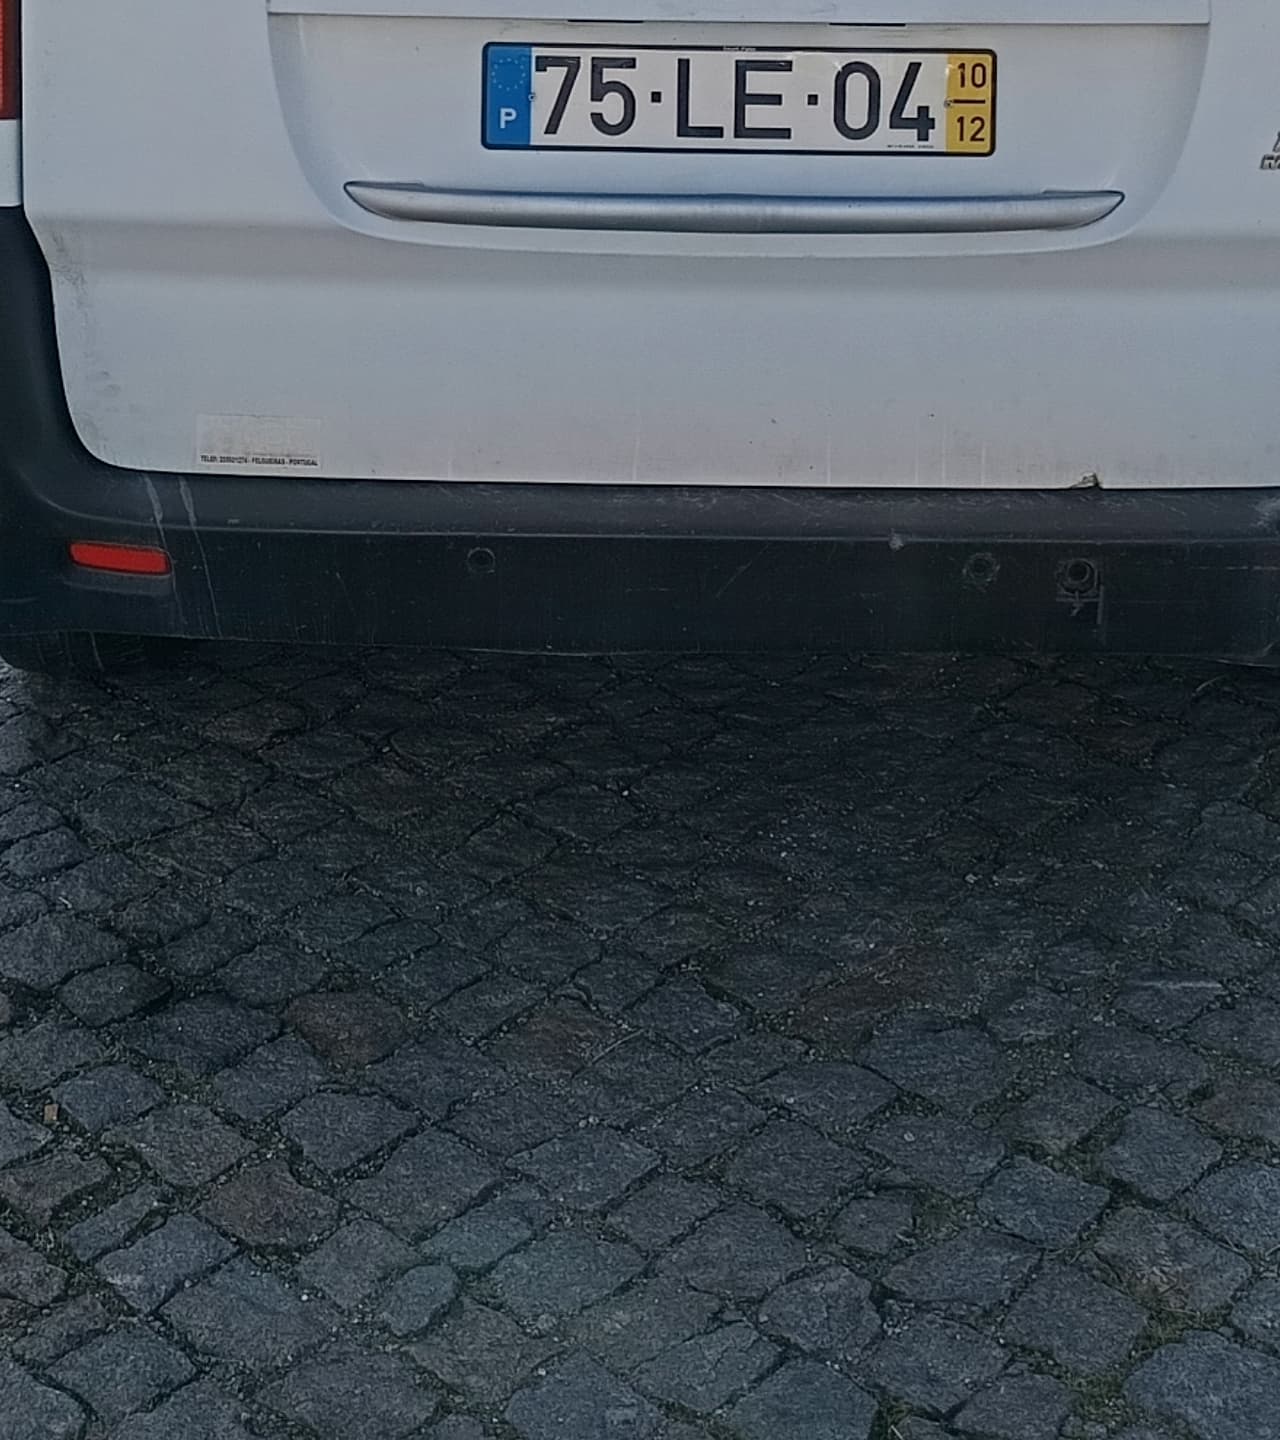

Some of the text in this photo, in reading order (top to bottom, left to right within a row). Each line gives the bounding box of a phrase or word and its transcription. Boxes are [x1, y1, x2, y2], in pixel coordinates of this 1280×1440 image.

[957, 62, 987, 89] 10
[499, 108, 517, 129] P
[956, 116, 985, 142] 12
